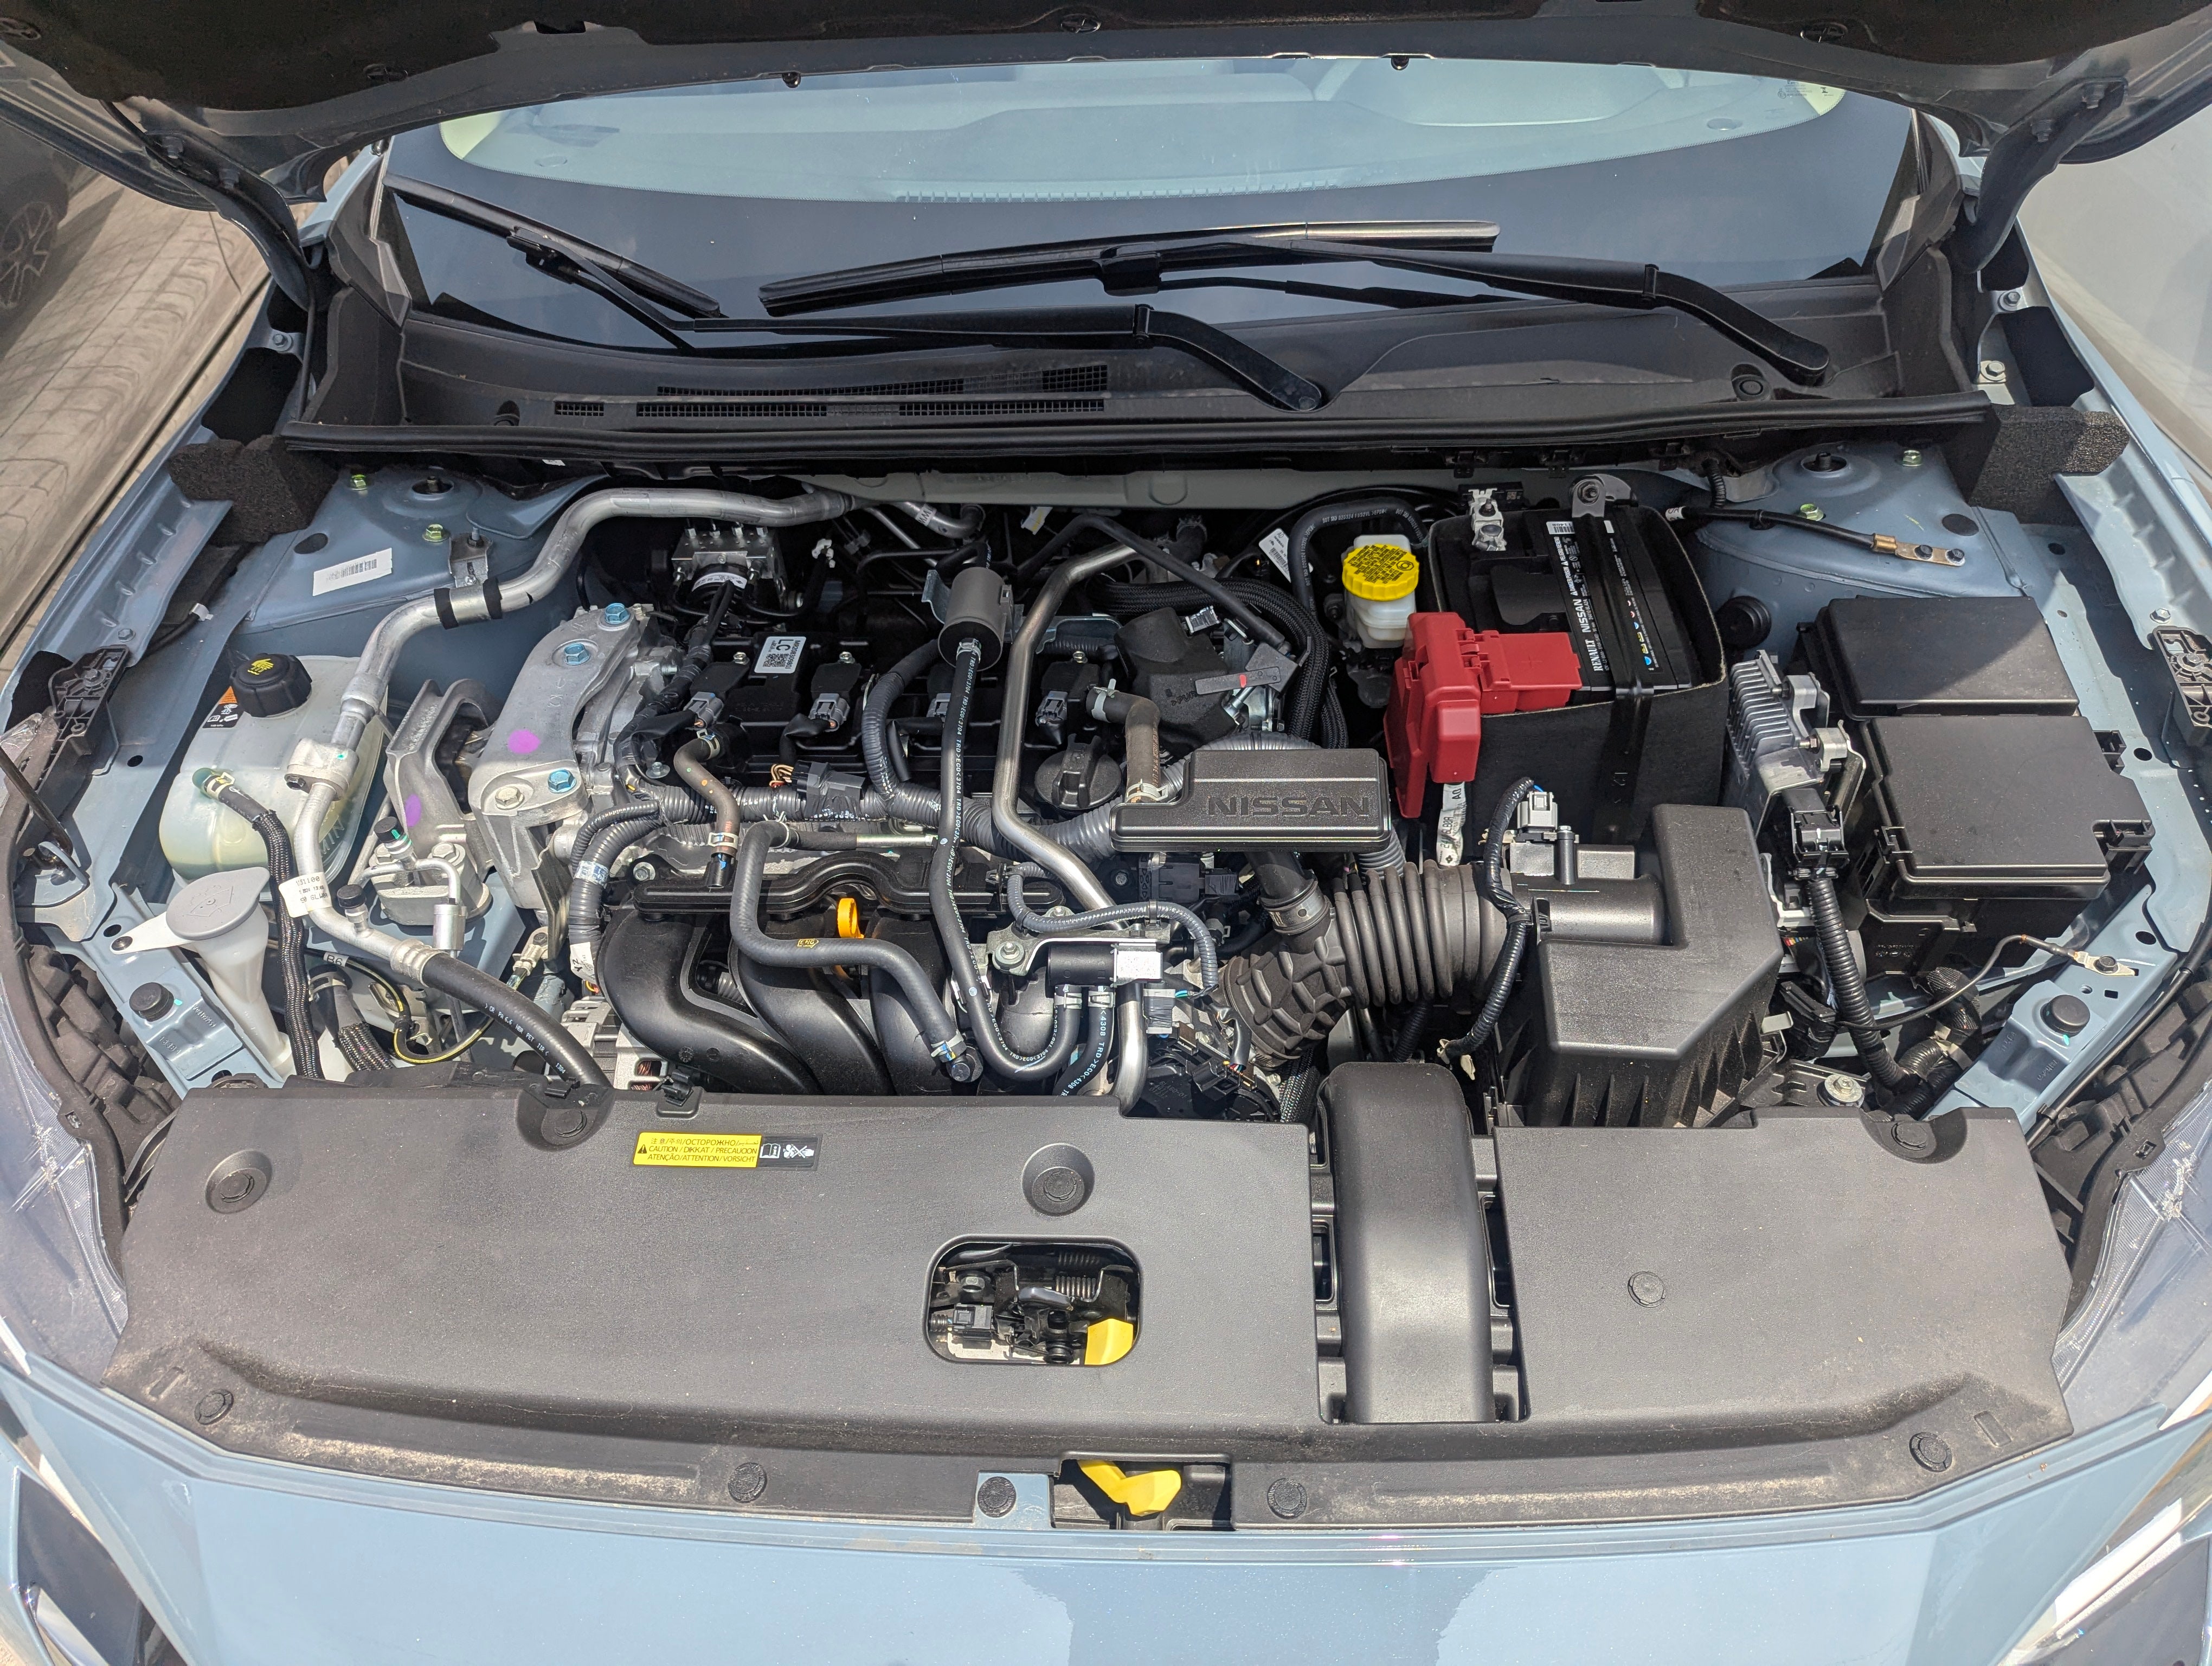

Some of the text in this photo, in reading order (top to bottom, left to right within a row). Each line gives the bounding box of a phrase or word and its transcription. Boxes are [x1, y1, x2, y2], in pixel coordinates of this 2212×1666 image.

[1573, 599, 1591, 633] NISSAN
[776, 639, 794, 650] LC
[1585, 639, 1603, 671] RENAULT
[1208, 797, 1369, 816] NISSAN
[327, 954, 343, 965] B6
[526, 1033, 535, 1042] PET
[1009, 1049, 1049, 1061] TRD>ECO<3704
[1068, 1042, 1105, 1089] TRD>ECO<4308
